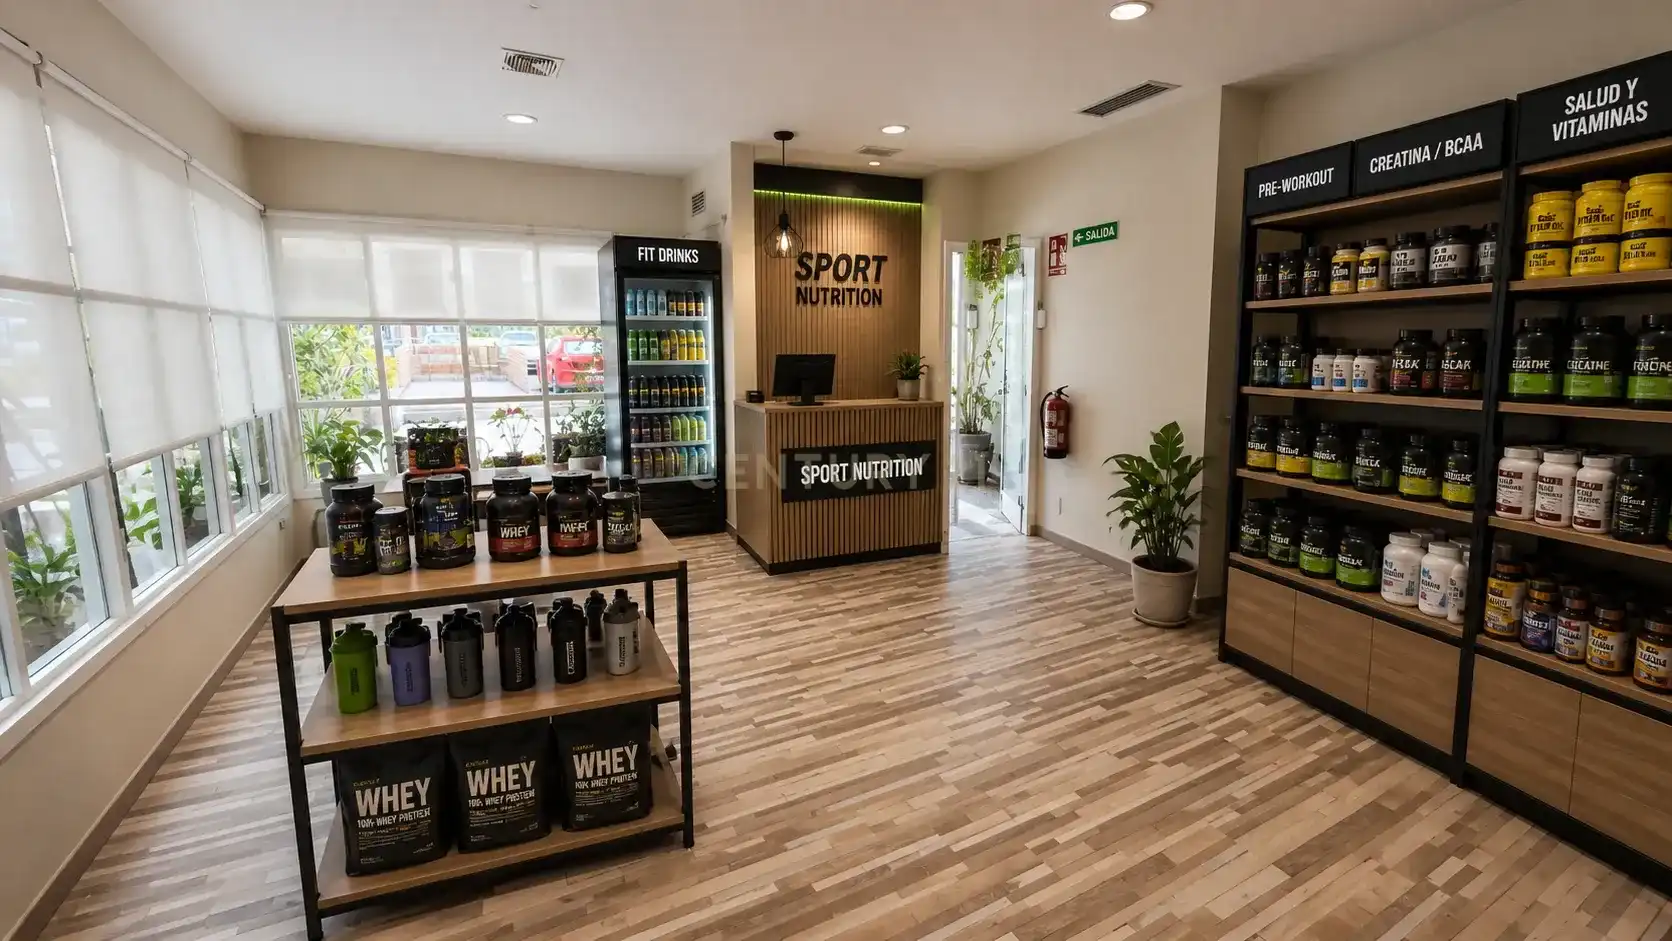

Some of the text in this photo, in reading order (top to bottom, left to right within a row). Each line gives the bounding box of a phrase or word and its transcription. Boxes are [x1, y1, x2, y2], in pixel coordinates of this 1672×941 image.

[1564, 76, 1640, 115] SALUD Y
[1552, 100, 1649, 142] VITAMINAS
[1369, 145, 1431, 174] CREATINA
[1444, 132, 1484, 158] BCAA
[1257, 167, 1335, 199] PRE-WORKOUT
[1085, 226, 1115, 241] SALIDA
[637, 246, 699, 264] FIT DRINKS
[794, 251, 888, 284] SPORT
[795, 286, 883, 308] NUTRITION
[800, 457, 923, 485] SPORT NUTRITION
[500, 525, 530, 539] WHEY
[466, 760, 537, 797] WHEY
[573, 744, 639, 780] WHEY
[355, 777, 431, 817] WHEY
